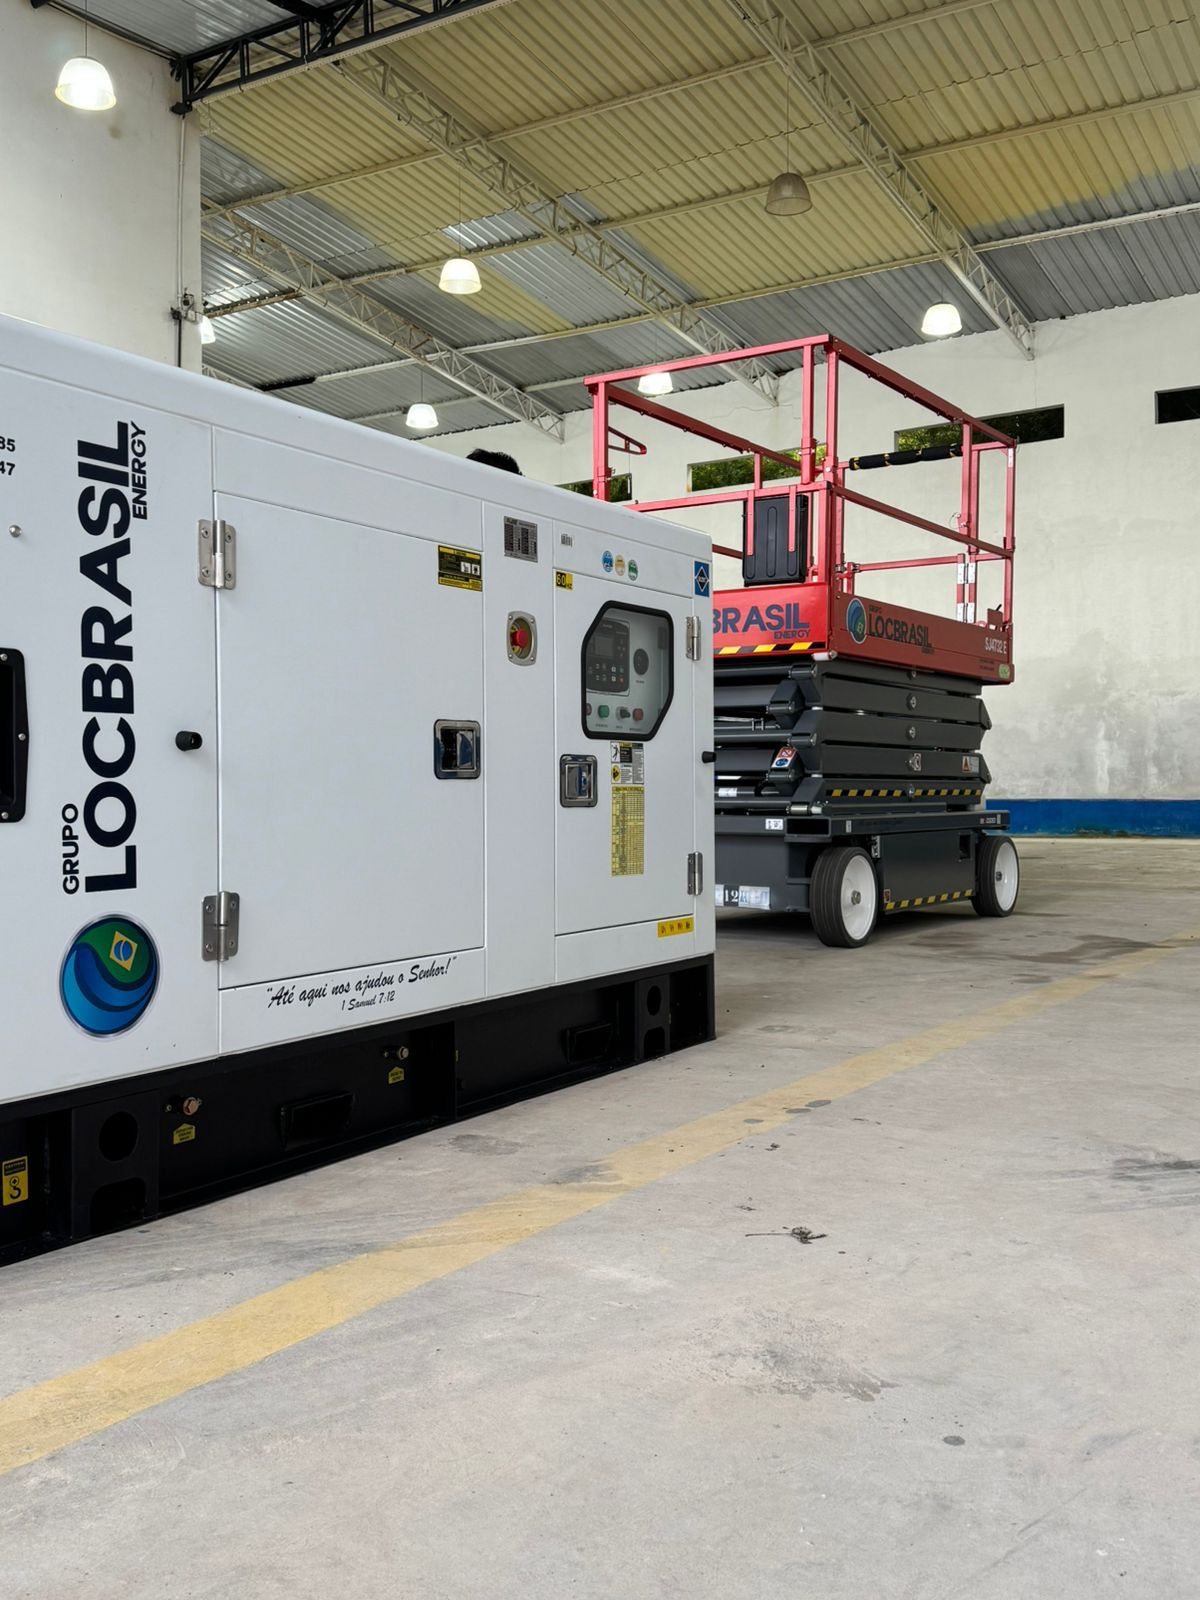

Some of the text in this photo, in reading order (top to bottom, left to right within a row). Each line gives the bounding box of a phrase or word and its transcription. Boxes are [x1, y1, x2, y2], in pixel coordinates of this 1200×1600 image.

[130, 421, 148, 520] ENERGY
[556, 573, 566, 586] 60
[773, 629, 811, 640] ENERGY
[868, 613, 932, 648] LOCBRASIL
[77, 420, 137, 893] LOCBRASIL
[62, 803, 79, 895] GRUPO
[298, 983, 327, 1007] aqui
[331, 981, 351, 996] nos
[355, 971, 395, 996] ajudou
[398, 972, 404, 984] o
[341, 990, 396, 1011] 1 Samuel 7:12
